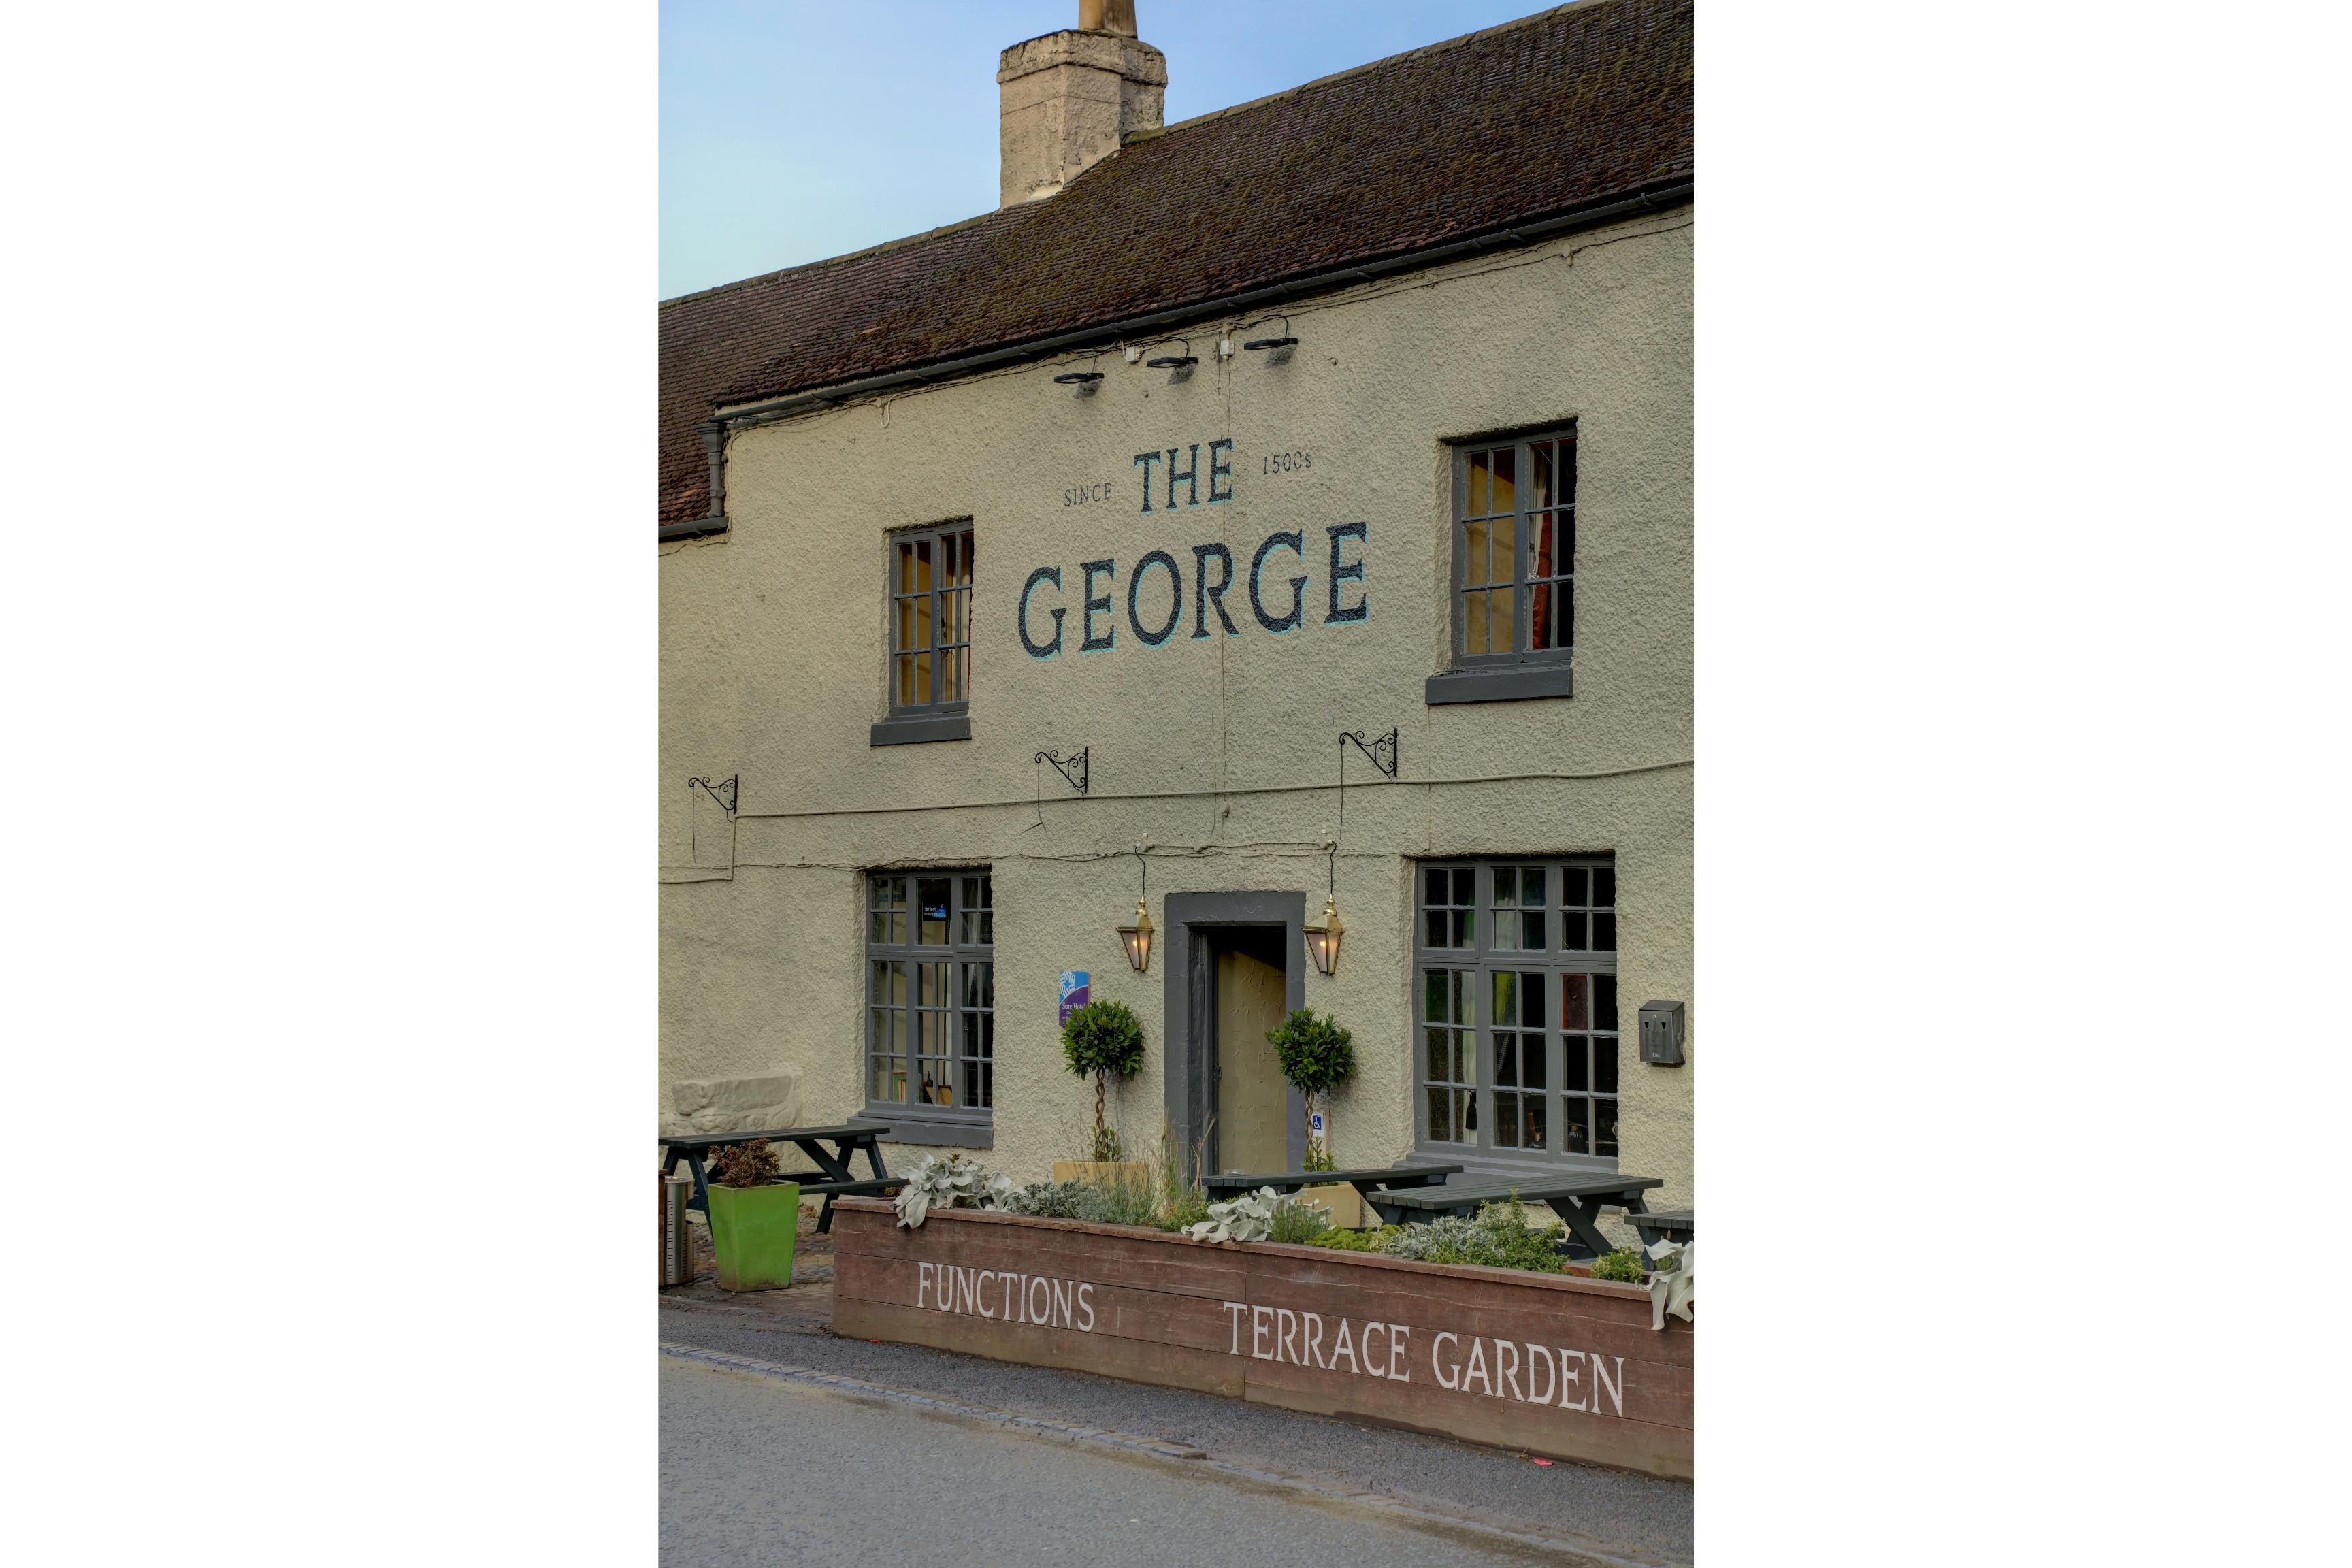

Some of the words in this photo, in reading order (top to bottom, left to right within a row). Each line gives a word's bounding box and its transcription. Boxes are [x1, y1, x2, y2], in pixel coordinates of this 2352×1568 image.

[1064, 483, 1111, 507] SINCE
[1134, 438, 1233, 514] THE
[1263, 451, 1311, 475] 1500s
[1018, 521, 1369, 659] GEORGE
[917, 1262, 1094, 1332] FUNCTIONS
[1223, 1301, 1410, 1382] TERRACE
[1433, 1331, 1625, 1417] GARDEN
